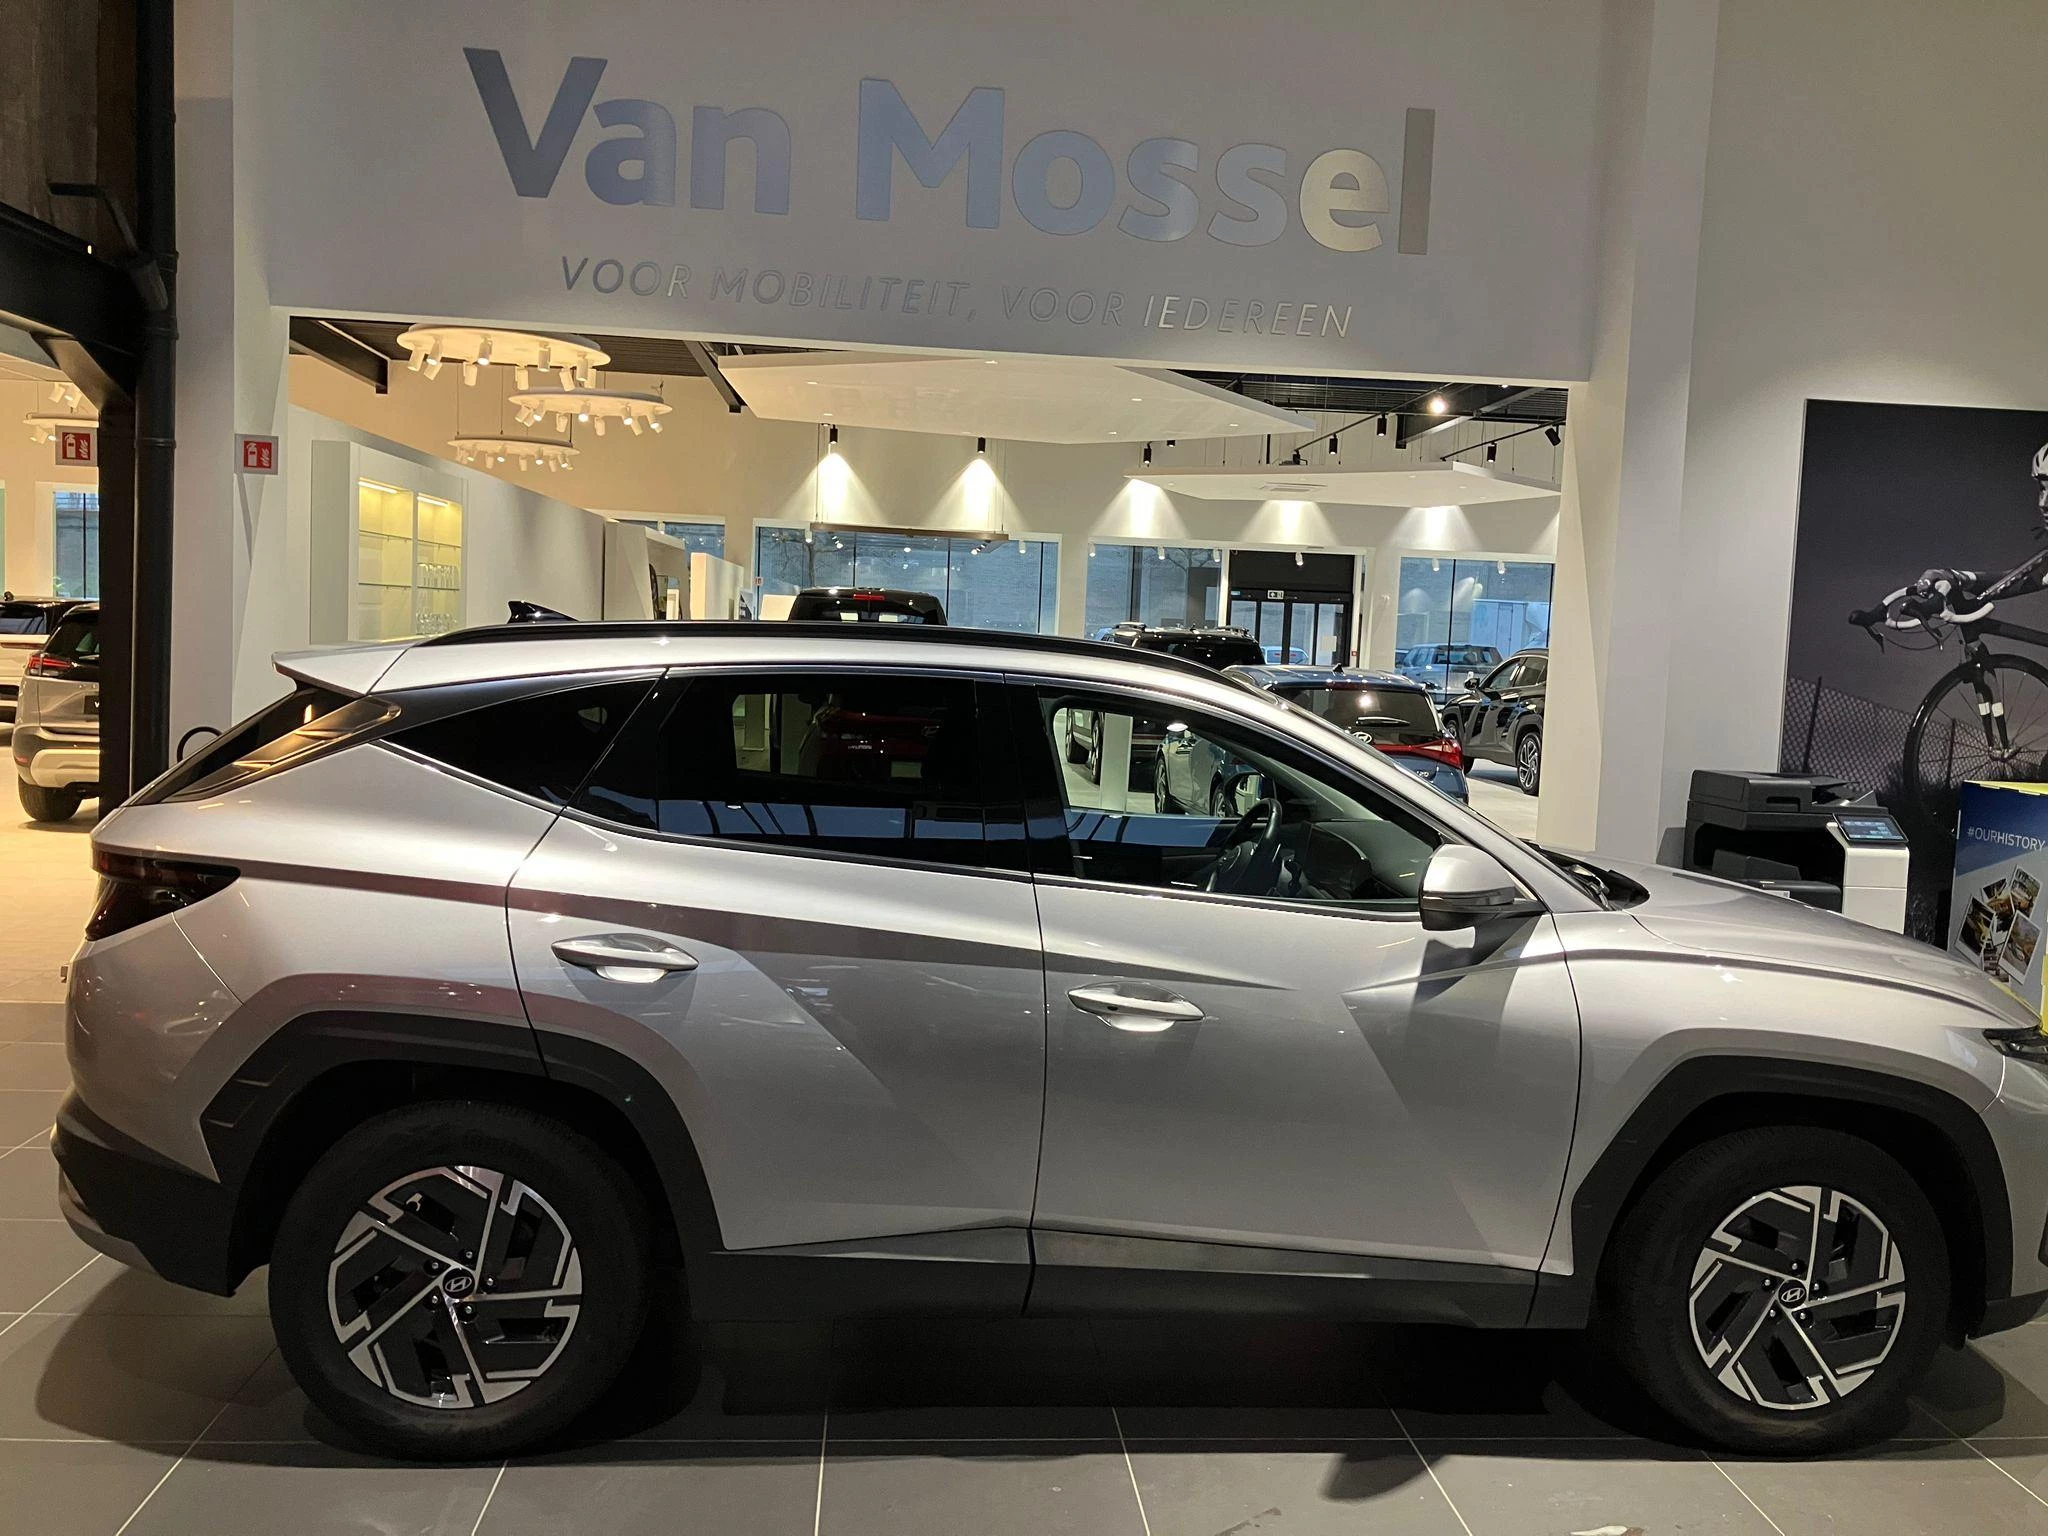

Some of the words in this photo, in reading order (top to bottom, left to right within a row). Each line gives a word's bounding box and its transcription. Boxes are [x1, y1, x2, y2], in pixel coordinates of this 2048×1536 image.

[462, 47, 791, 215] Van
[856, 77, 1436, 256] Mossel
[561, 255, 693, 300] VOOR
[709, 265, 977, 323] MOBILITEIT,
[1001, 286, 1126, 328] VOOR
[1143, 294, 1353, 339] IEDEREEN
[1966, 826, 2046, 852] #OURHISTORY
